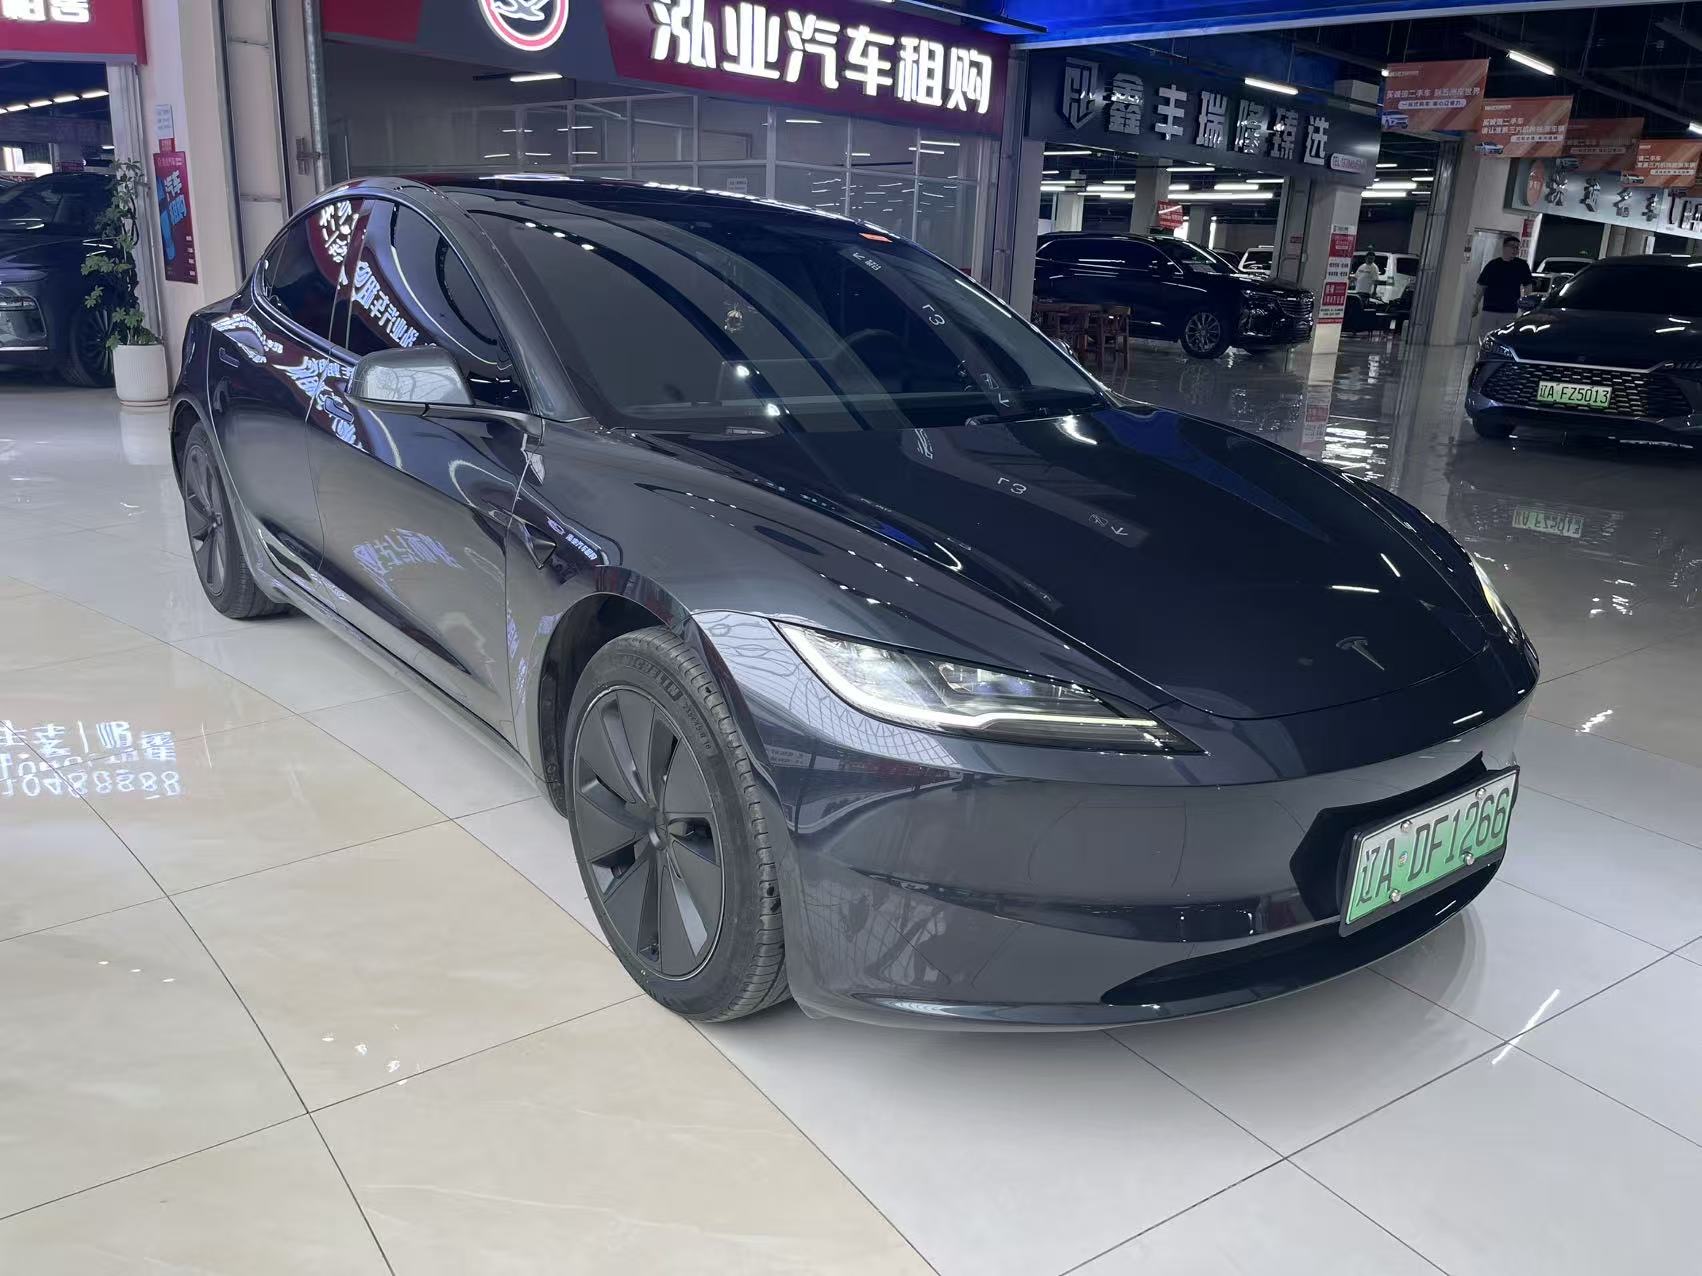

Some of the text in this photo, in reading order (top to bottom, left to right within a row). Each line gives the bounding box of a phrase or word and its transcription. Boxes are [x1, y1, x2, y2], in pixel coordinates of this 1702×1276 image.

[651, 0, 993, 114] 泓业汽车租购
